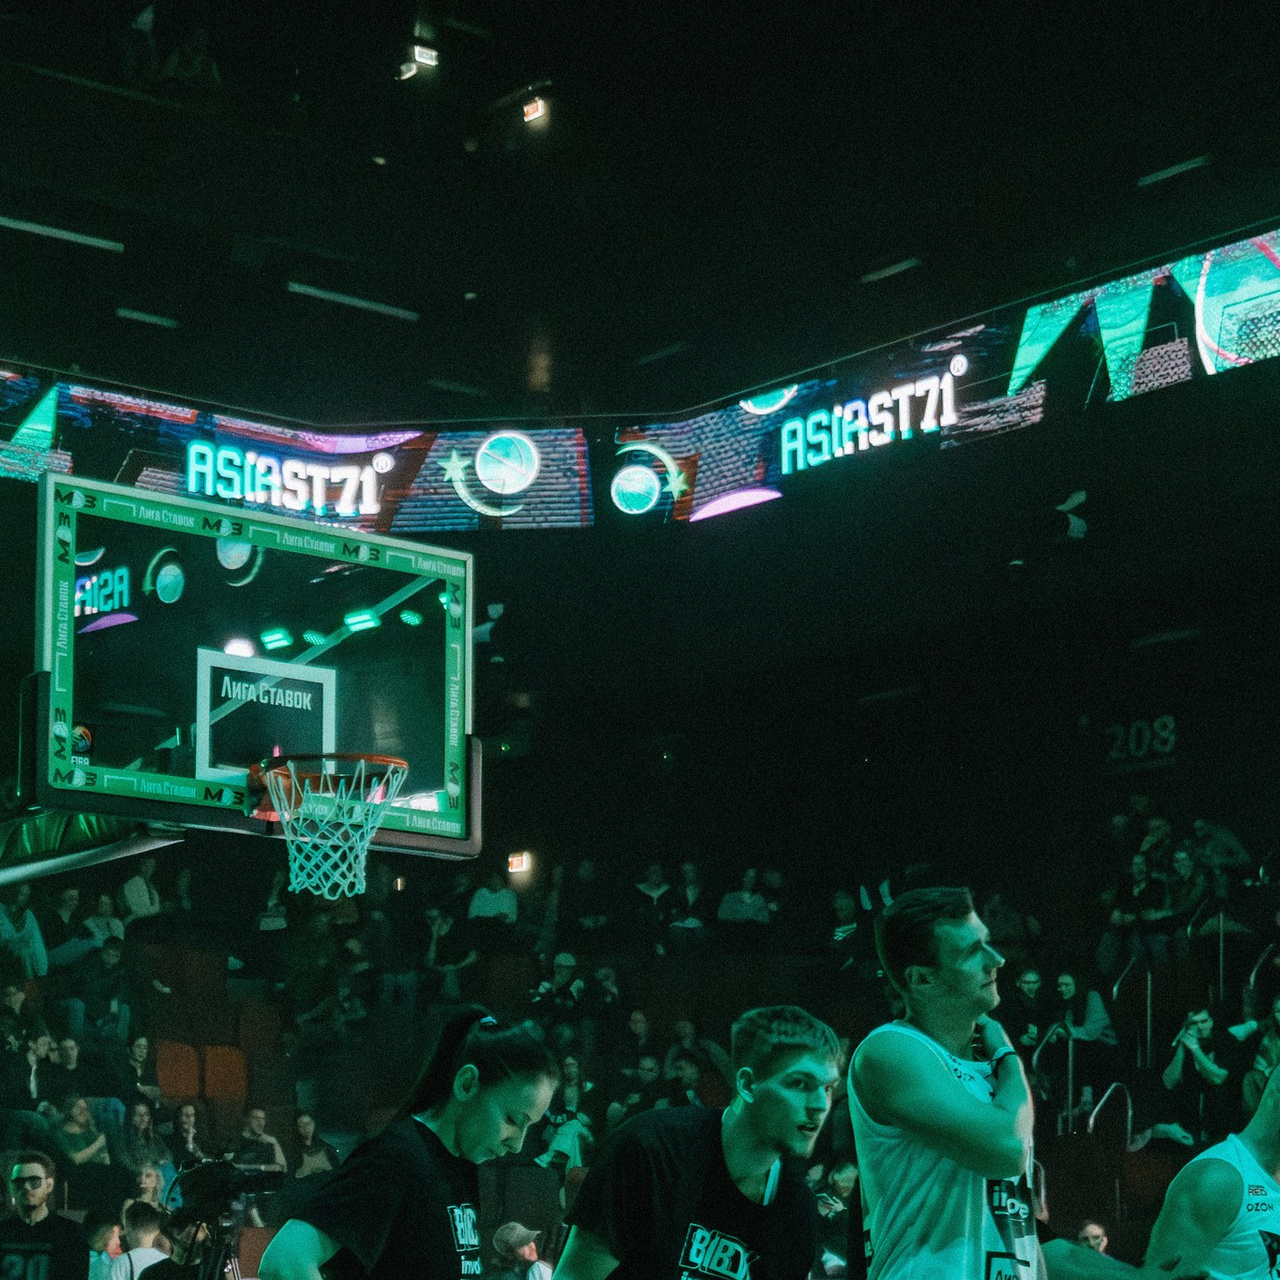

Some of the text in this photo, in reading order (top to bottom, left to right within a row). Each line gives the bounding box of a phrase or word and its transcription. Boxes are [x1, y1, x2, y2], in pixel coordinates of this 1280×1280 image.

[138, 506, 160, 521] Лига
[221, 675, 312, 711] Лига Ставок
[1246, 1202, 1274, 1212] OZON
